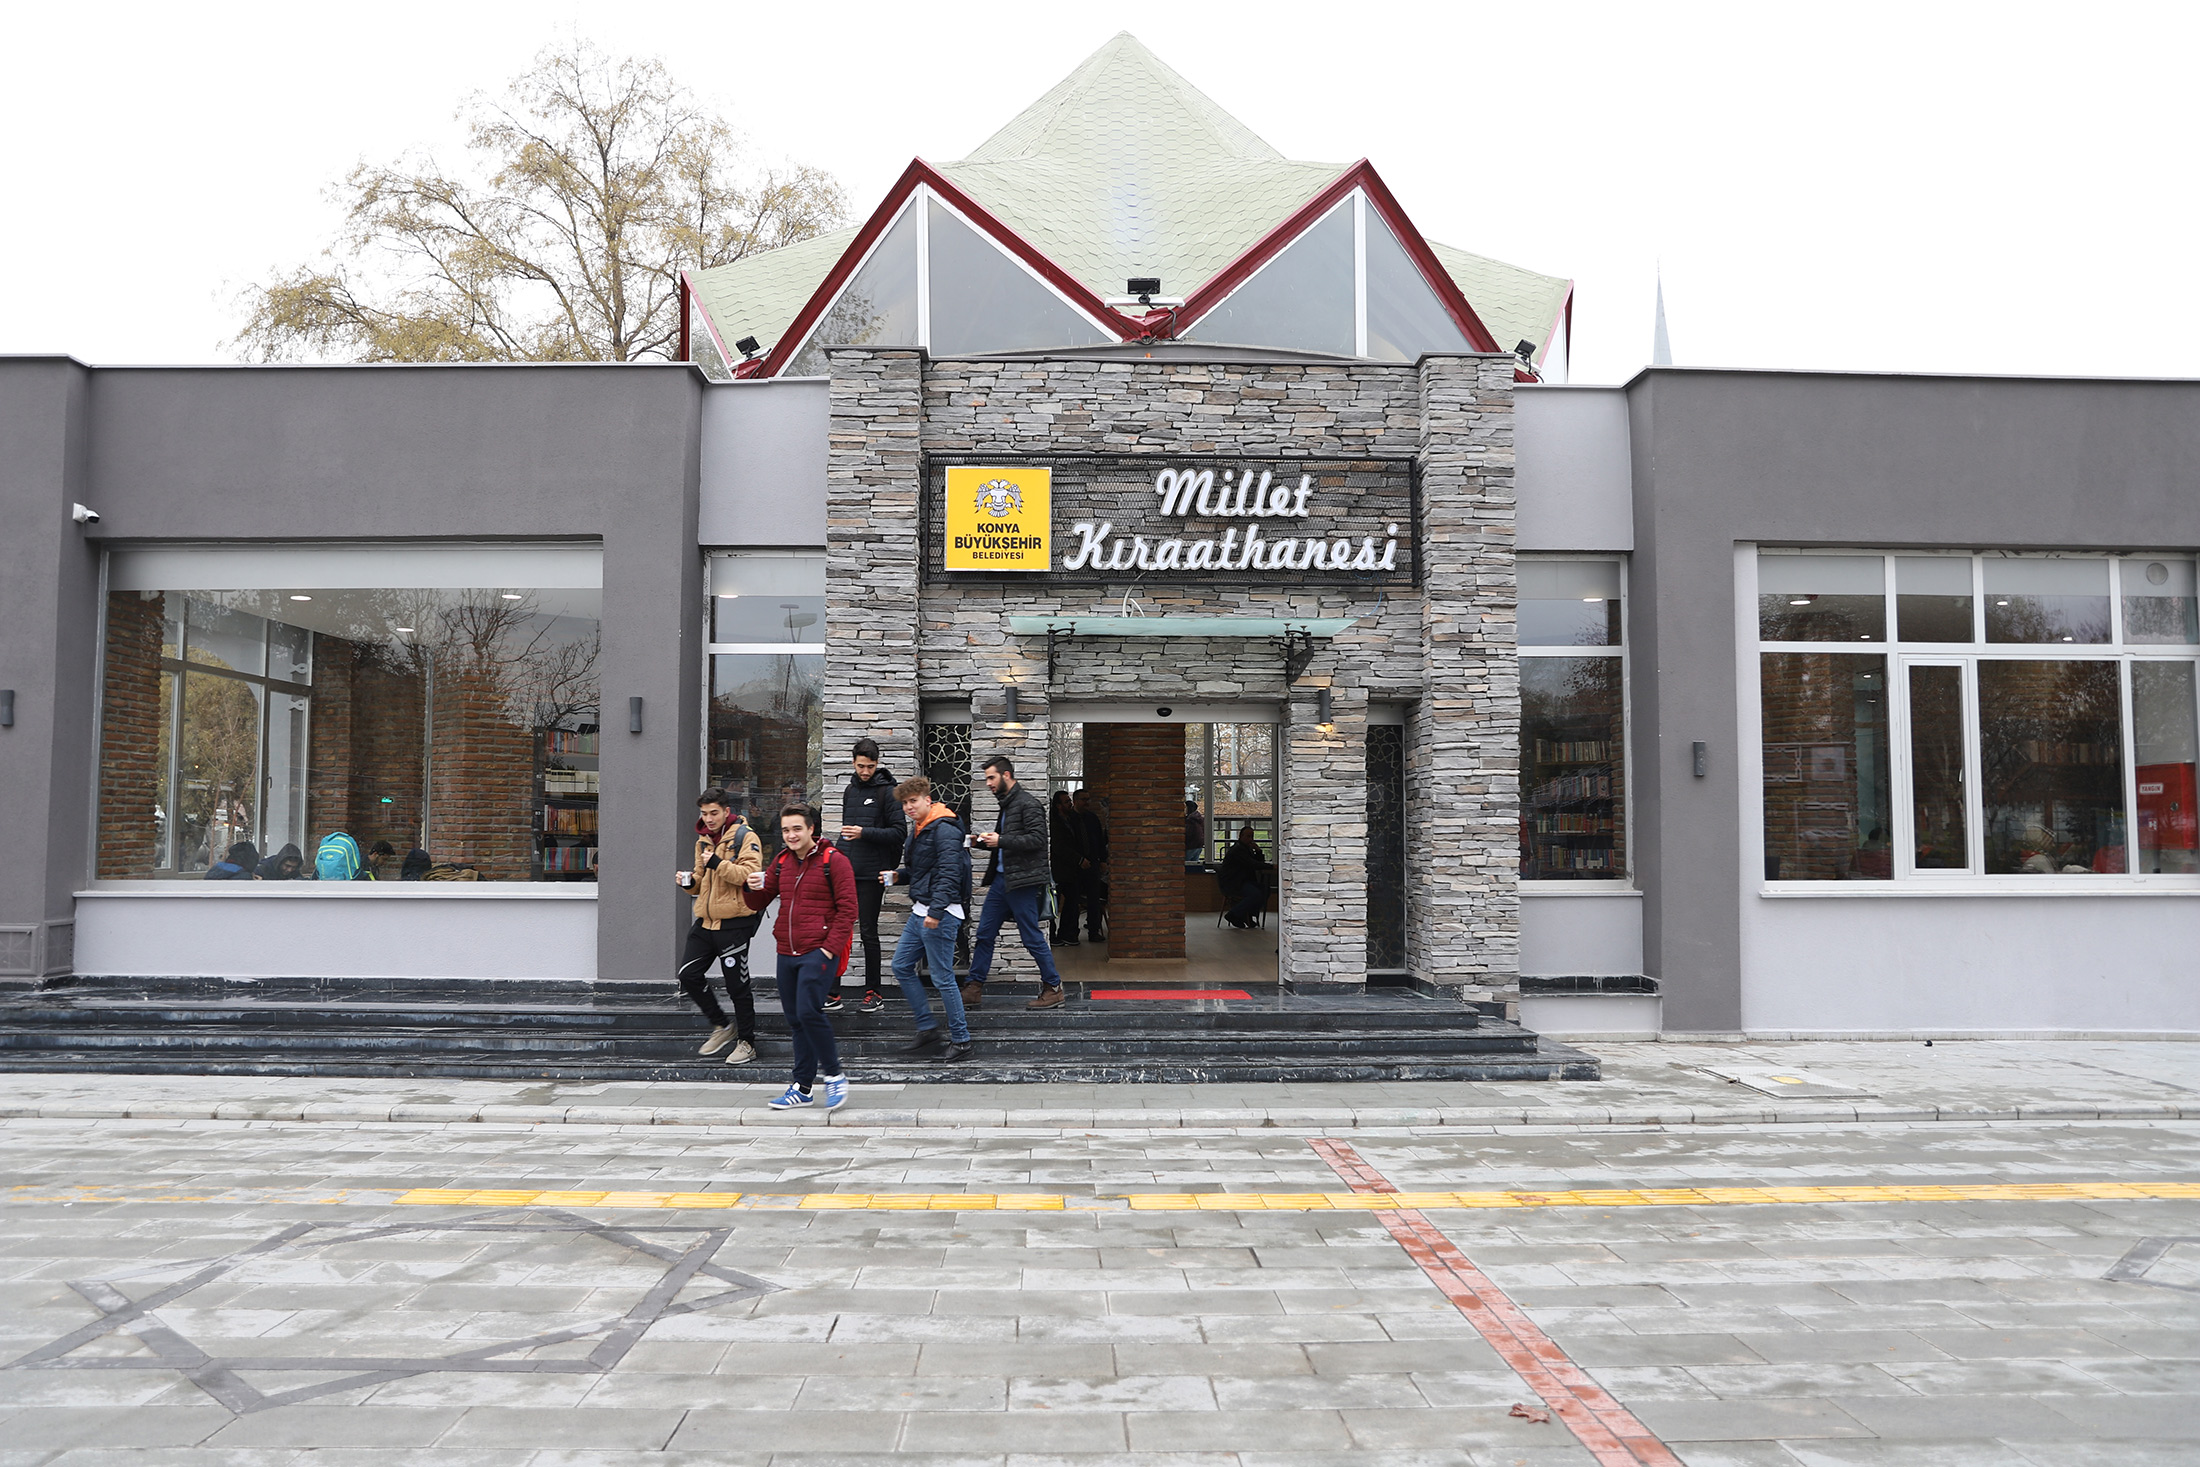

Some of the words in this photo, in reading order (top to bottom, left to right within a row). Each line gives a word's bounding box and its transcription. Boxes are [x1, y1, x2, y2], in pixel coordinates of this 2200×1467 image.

[1155, 467, 1313, 518] Millet
[977, 523, 1020, 533] KONYA
[954, 534, 1042, 551] BÜYÜKŞEHİR
[1062, 522, 1399, 571] Kıraathanesi
[972, 550, 1024, 559] BELEDİYESİ
